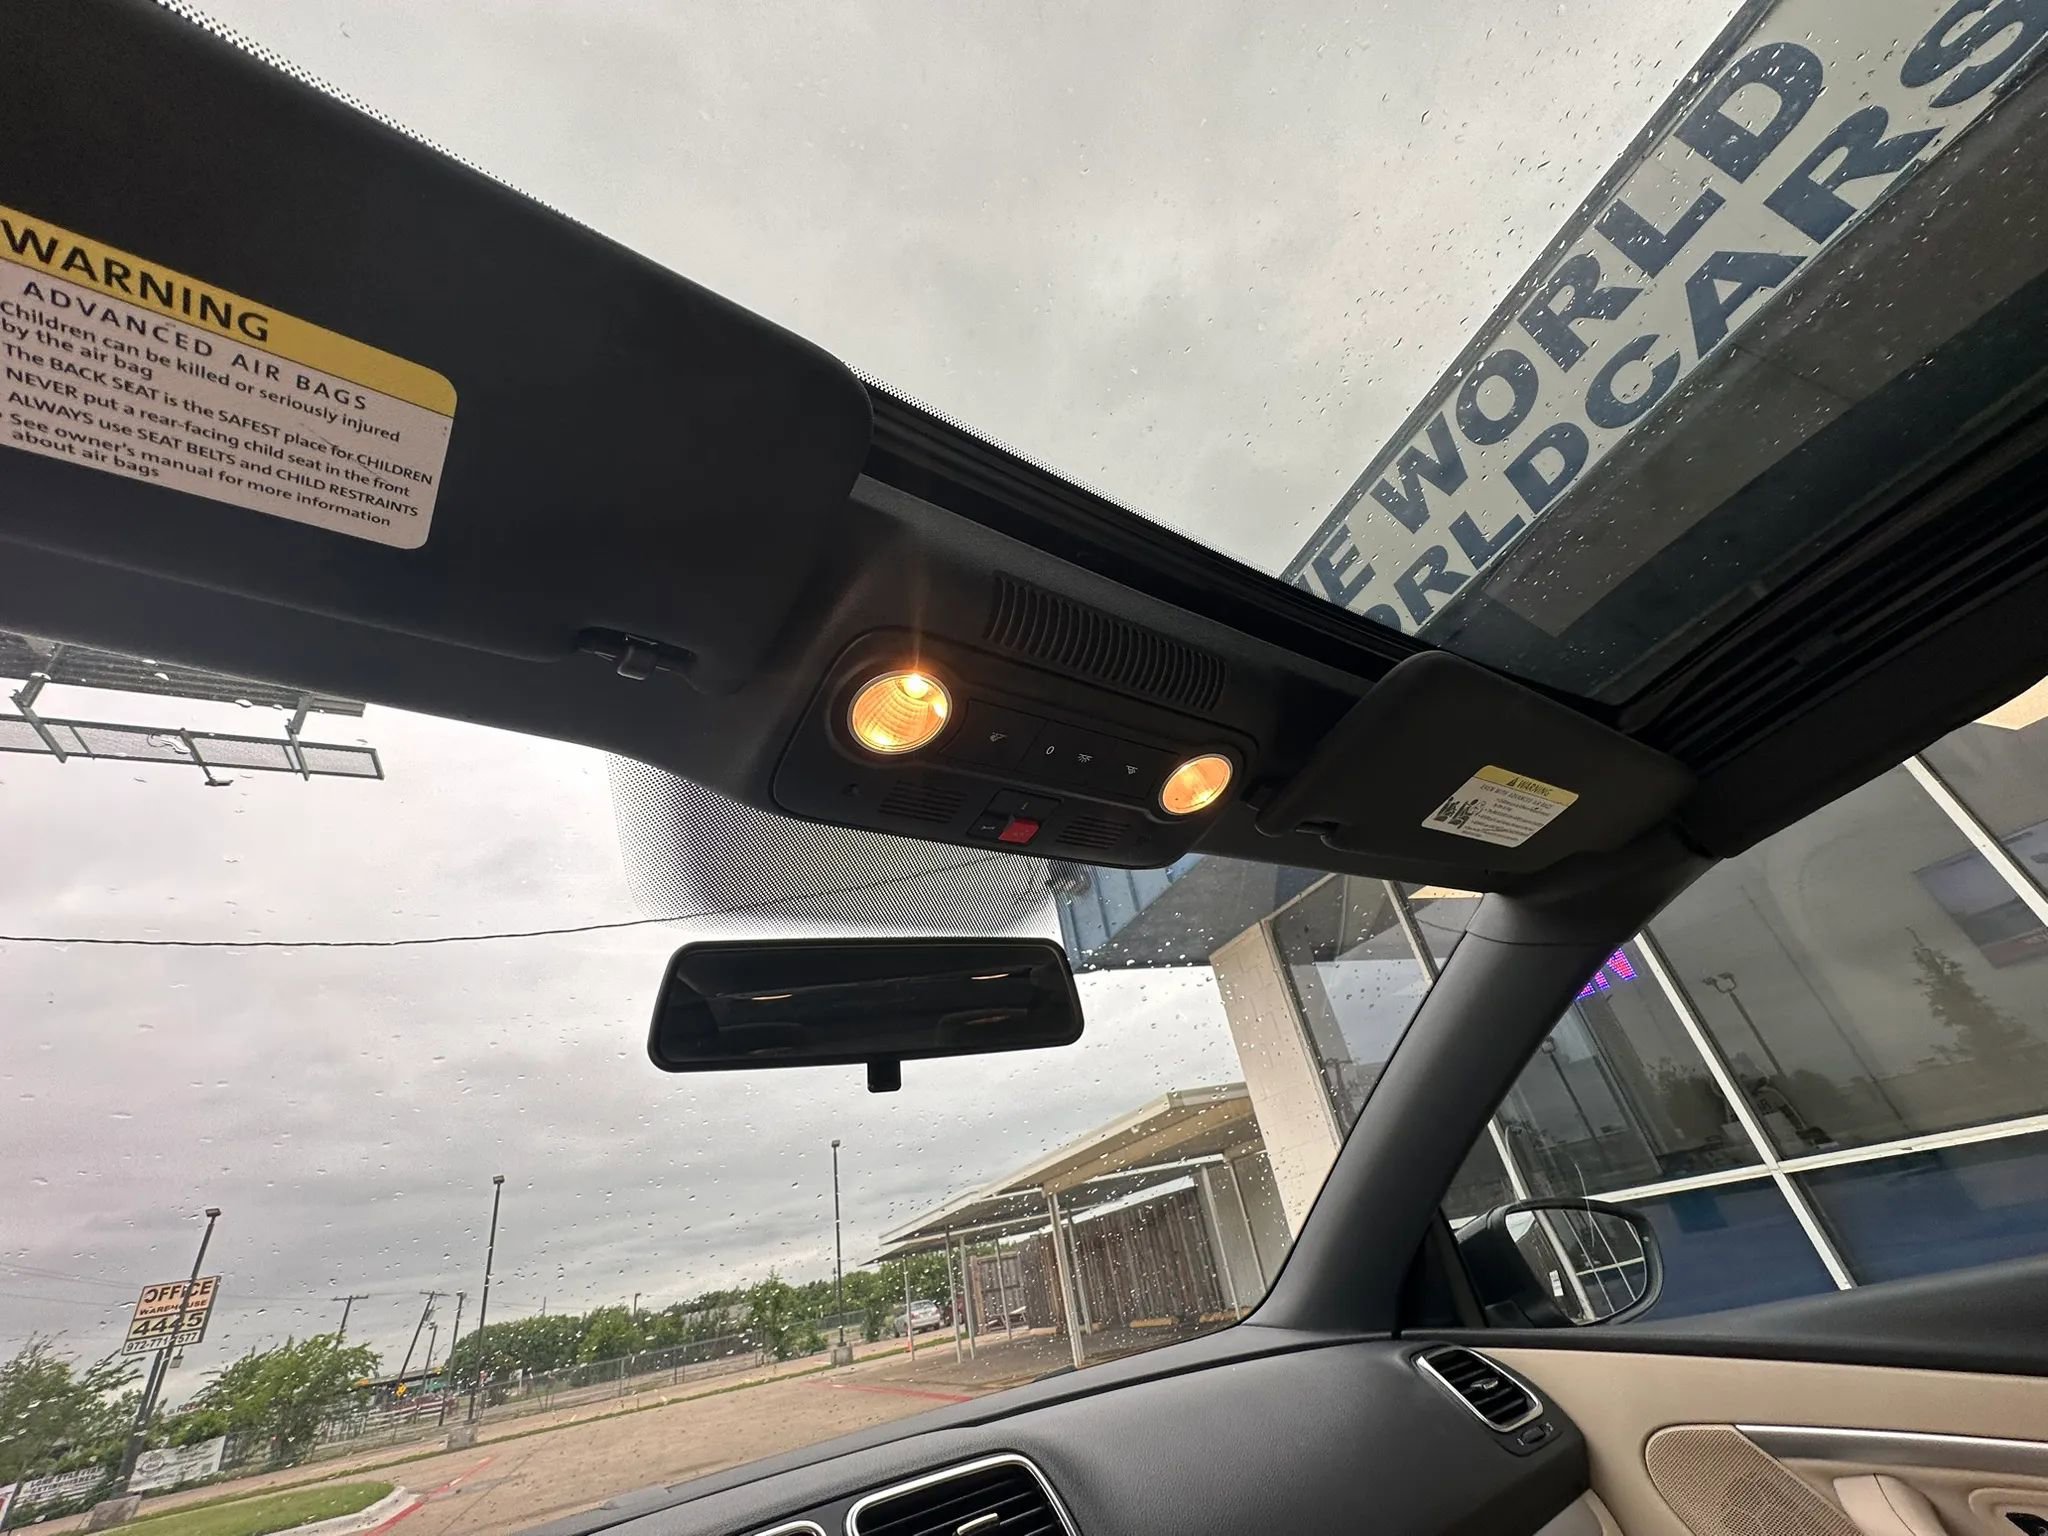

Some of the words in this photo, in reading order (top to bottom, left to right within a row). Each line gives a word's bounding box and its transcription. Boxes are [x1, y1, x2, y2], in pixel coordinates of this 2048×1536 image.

[0, 218, 270, 343] WARNING
[1370, 42, 1824, 534] WORLD
[0, 300, 96, 343] Children
[103, 337, 139, 357] can
[146, 345, 171, 368] be
[177, 357, 230, 386] killed
[235, 379, 254, 394] or
[259, 388, 338, 424] seriously
[343, 413, 401, 443] injured
[2, 318, 29, 340] by
[37, 329, 73, 352] the
[80, 346, 108, 363] air
[114, 354, 153, 381] bag
[23, 281, 213, 358] ADVANCED
[231, 353, 280, 382] AIR
[296, 374, 367, 411] BAGS
[3, 342, 44, 367] The
[50, 357, 107, 386] BACK
[112, 376, 160, 401] SEAT
[164, 392, 178, 407] is
[182, 398, 214, 419] the
[218, 410, 281, 437] SAFEST
[284, 432, 327, 453] place
[331, 444, 353, 460] for
[356, 453, 433, 485] CHILDREN
[6, 367, 78, 399] NEVER
[84, 392, 118, 410] put
[124, 404, 135, 415] a
[140, 409, 239, 449] rear-facing
[244, 439, 284, 461] child
[288, 453, 321, 471] seat
[326, 462, 340, 477] in
[344, 468, 369, 485] the
[373, 477, 410, 497] front
[8, 391, 94, 425] ALWAYS
[100, 419, 132, 436] use
[137, 427, 182, 450] SEAT
[186, 442, 236, 465] BELTS
[240, 458, 272, 476] and
[276, 468, 326, 490] CHILD
[329, 484, 419, 517] RESTRAINTS
[10, 412, 48, 433] See
[55, 428, 135, 457] owner's
[142, 449, 213, 479] manual
[218, 470, 243, 486] for
[247, 480, 292, 500] more
[297, 492, 391, 527] information
[13, 429, 76, 455] about
[82, 451, 108, 463] air
[114, 455, 160, 478] bags
[1516, 778, 1553, 797] WARNING
[140, 1300, 207, 1316] WAREHUSE
